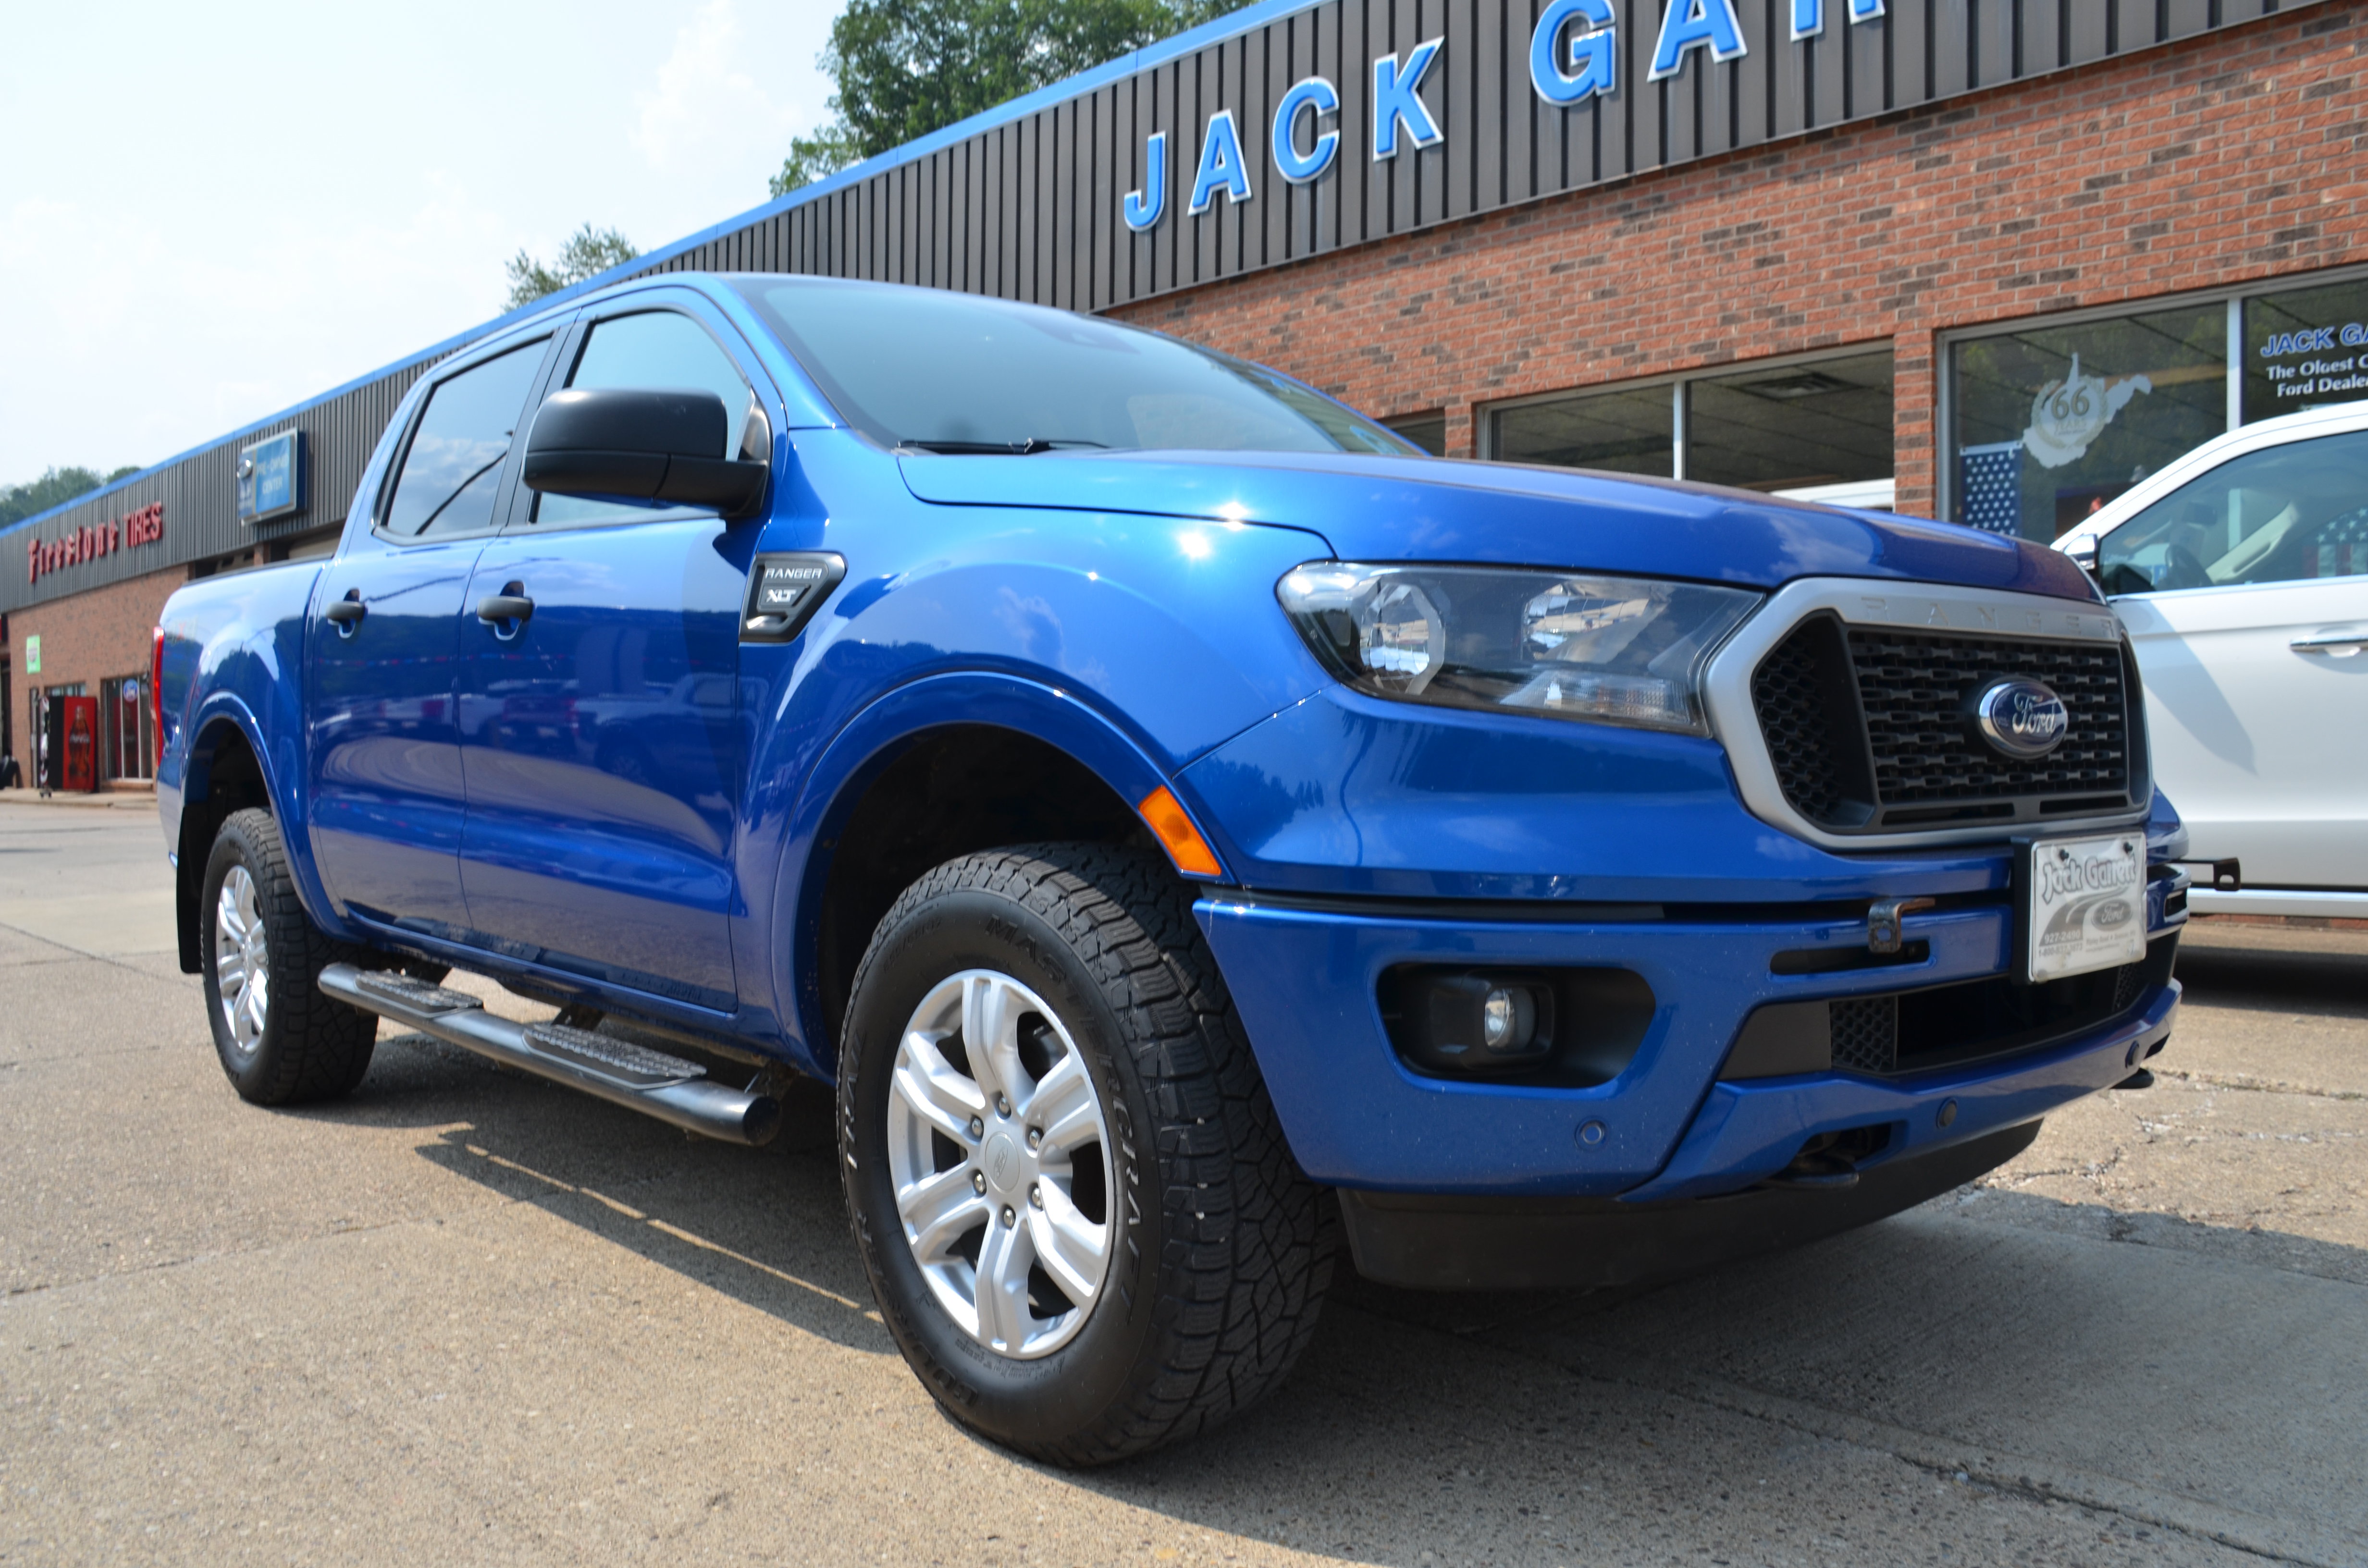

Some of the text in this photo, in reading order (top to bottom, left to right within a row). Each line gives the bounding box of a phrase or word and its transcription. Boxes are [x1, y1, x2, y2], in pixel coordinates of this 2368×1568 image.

[1123, 36, 1444, 233] JACK
[2260, 326, 2335, 358] JACK
[2266, 365, 2295, 380] The
[2277, 378, 2314, 398] Ford
[2051, 385, 2089, 420] 66
[28, 501, 163, 584] Firestone TIRES
[765, 568, 822, 579] RANGER
[766, 589, 796, 602] XLT
[1861, 596, 2114, 639] RANGER
[2012, 692, 2056, 734] Ford
[2042, 858, 2083, 905] Jack
[2101, 904, 2124, 923] Ford
[844, 1028, 867, 1173] TRAIL
[985, 914, 1143, 1327] MASTERCRAFT
